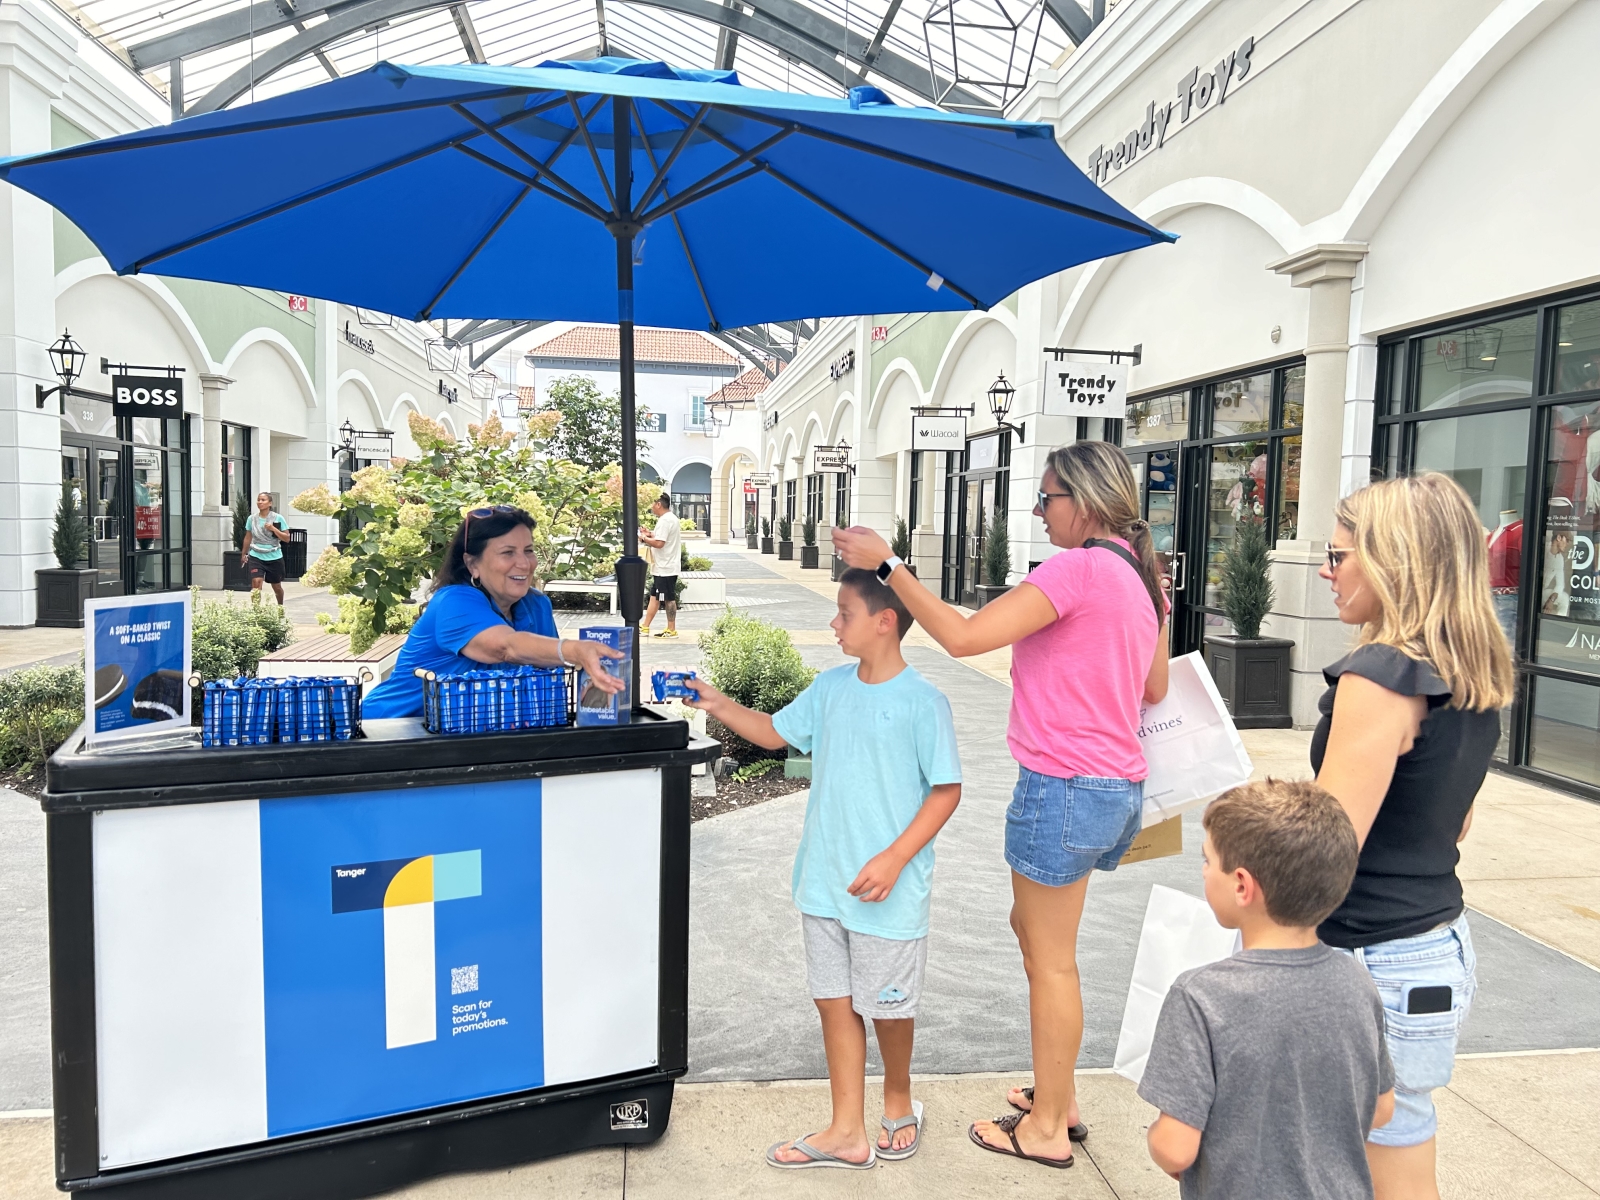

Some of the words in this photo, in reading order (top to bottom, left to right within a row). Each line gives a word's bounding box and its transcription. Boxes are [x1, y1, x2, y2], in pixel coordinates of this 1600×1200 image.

[1088, 100, 1172, 186] Trendy
[1177, 35, 1255, 124] Toys
[292, 296, 305, 311] 3C
[871, 327, 887, 340] 13A
[1058, 372, 1117, 393] Trendy
[116, 387, 178, 407] BOSS
[1067, 388, 1106, 406] Toys
[82, 410, 94, 422] 338
[1146, 414, 1161, 428] 1387
[930, 429, 959, 438] Wacoal
[357, 445, 390, 453] francesca's
[1567, 545, 1585, 560] the
[1569, 595, 1583, 603] OUR
[110, 626, 115, 636] A
[115, 622, 152, 636] SOFT-BAKED
[152, 620, 171, 631] TWIST
[585, 630, 613, 640] Tanger
[120, 635, 130, 645] ON
[131, 634, 136, 644] A
[137, 631, 161, 643] CLASSIC
[579, 706, 615, 714] Unbeatable
[335, 867, 367, 878] Tanger
[452, 1003, 477, 1014] Scan
[479, 1000, 493, 1010] for
[452, 1010, 487, 1024] today's
[452, 1018, 509, 1037] promotions.
